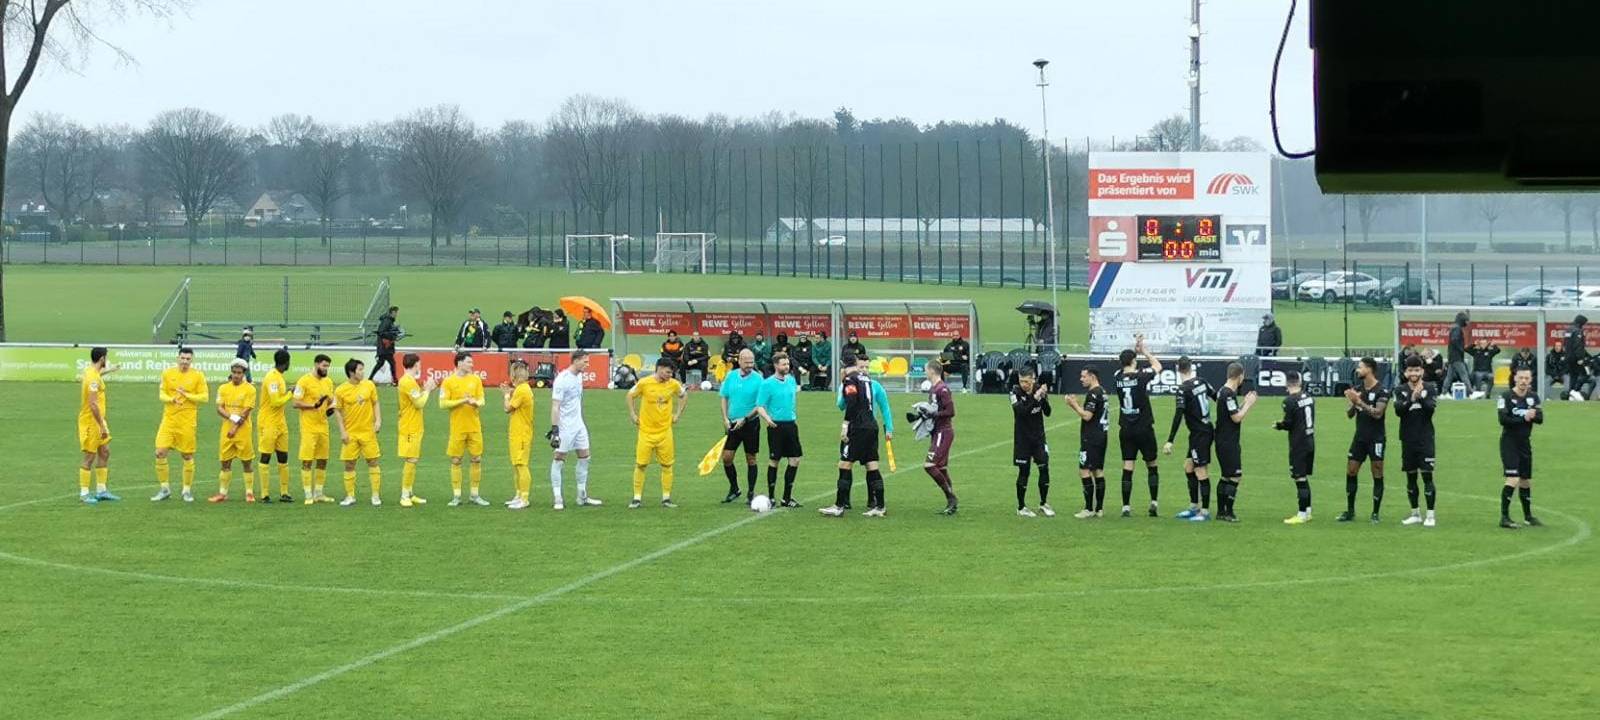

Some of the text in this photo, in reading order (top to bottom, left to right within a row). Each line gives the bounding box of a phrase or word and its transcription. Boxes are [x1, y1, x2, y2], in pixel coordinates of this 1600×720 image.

[1098, 172, 1191, 185] Das Ergebnis wird
[1098, 185, 1177, 197] präsentiert von
[1232, 186, 1260, 196] SWK
[1199, 247, 1219, 256] min
[629, 318, 656, 327] REWE
[702, 320, 728, 328] REWE
[774, 320, 801, 328] REWE
[848, 321, 875, 329] REWE
[914, 321, 941, 330] REWE
[1402, 328, 1430, 336] REWE
[1471, 329, 1500, 337] REWE
